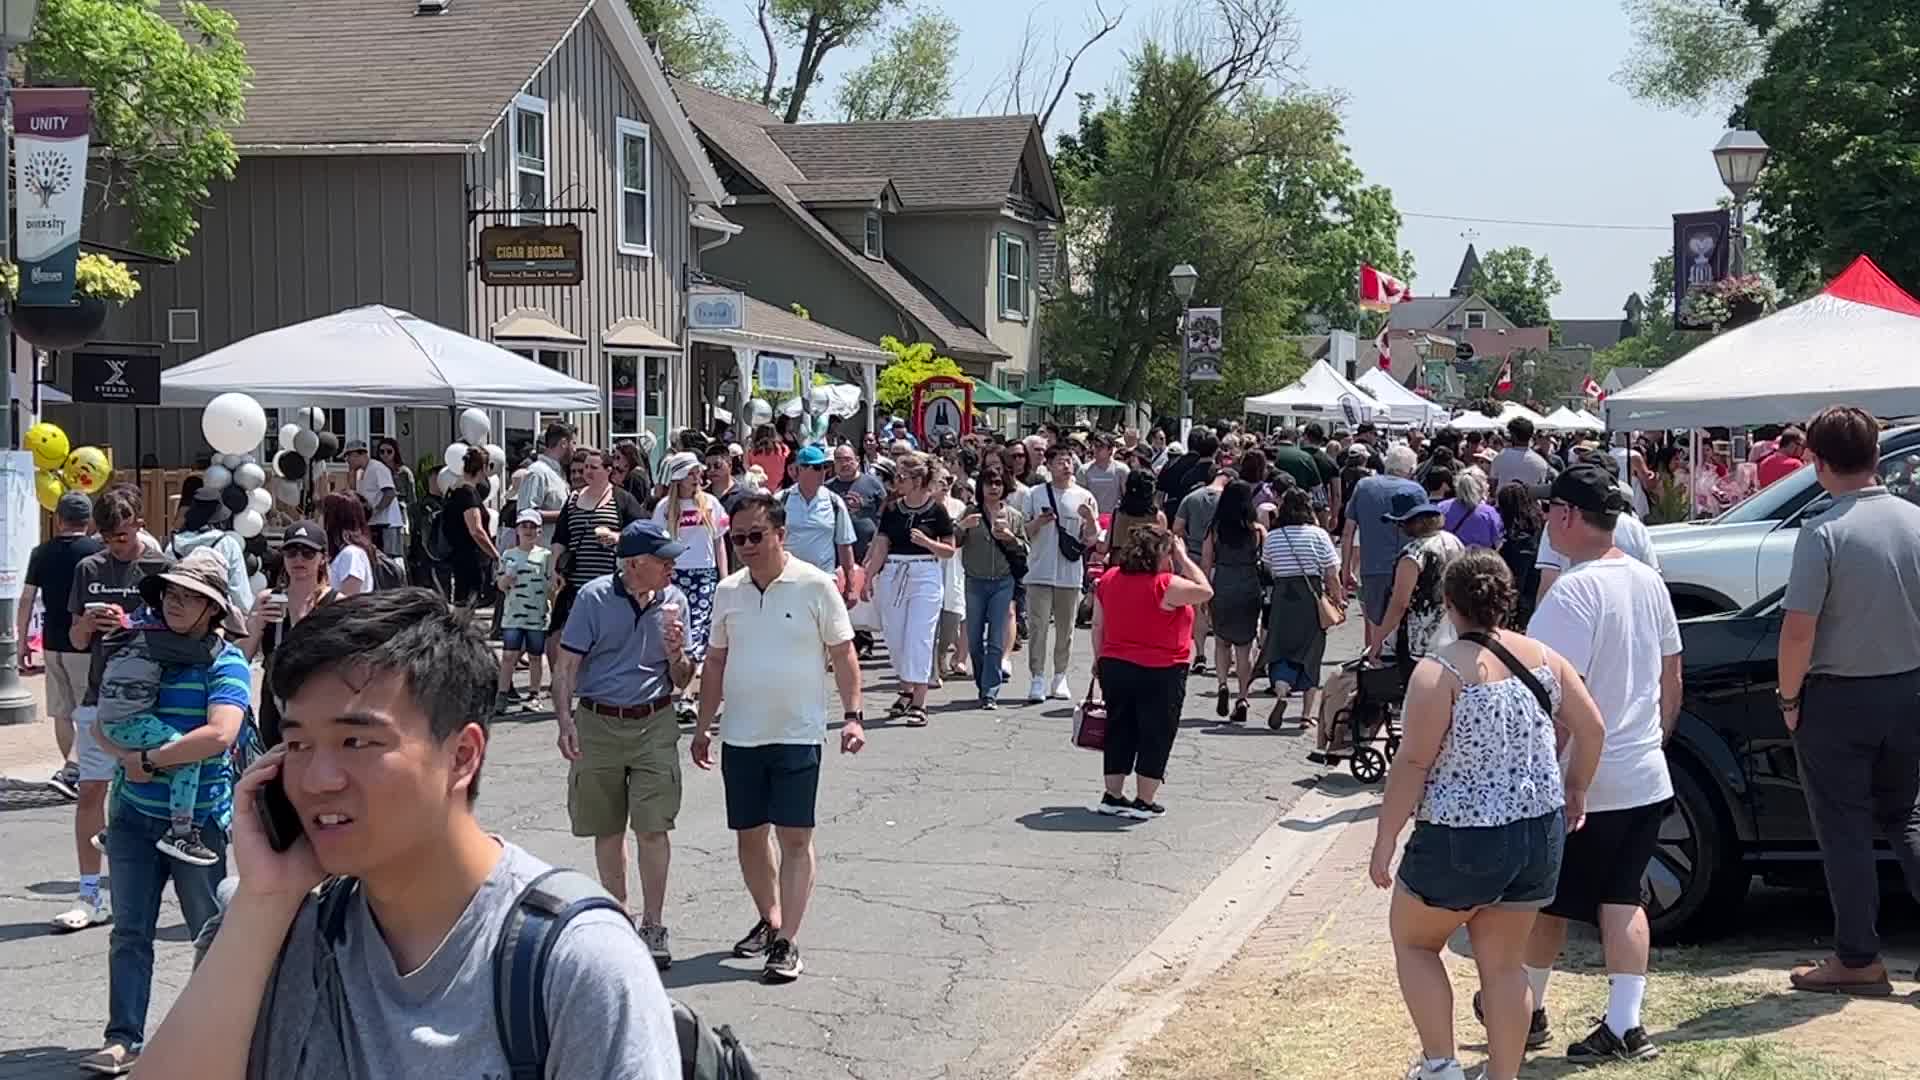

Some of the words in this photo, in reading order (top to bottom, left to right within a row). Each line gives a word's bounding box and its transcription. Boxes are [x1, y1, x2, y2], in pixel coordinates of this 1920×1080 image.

[31, 116, 69, 131] UNITY
[496, 246, 525, 258] CIGAR
[527, 246, 565, 258] BODEGA
[88, 582, 140, 598] Champi
